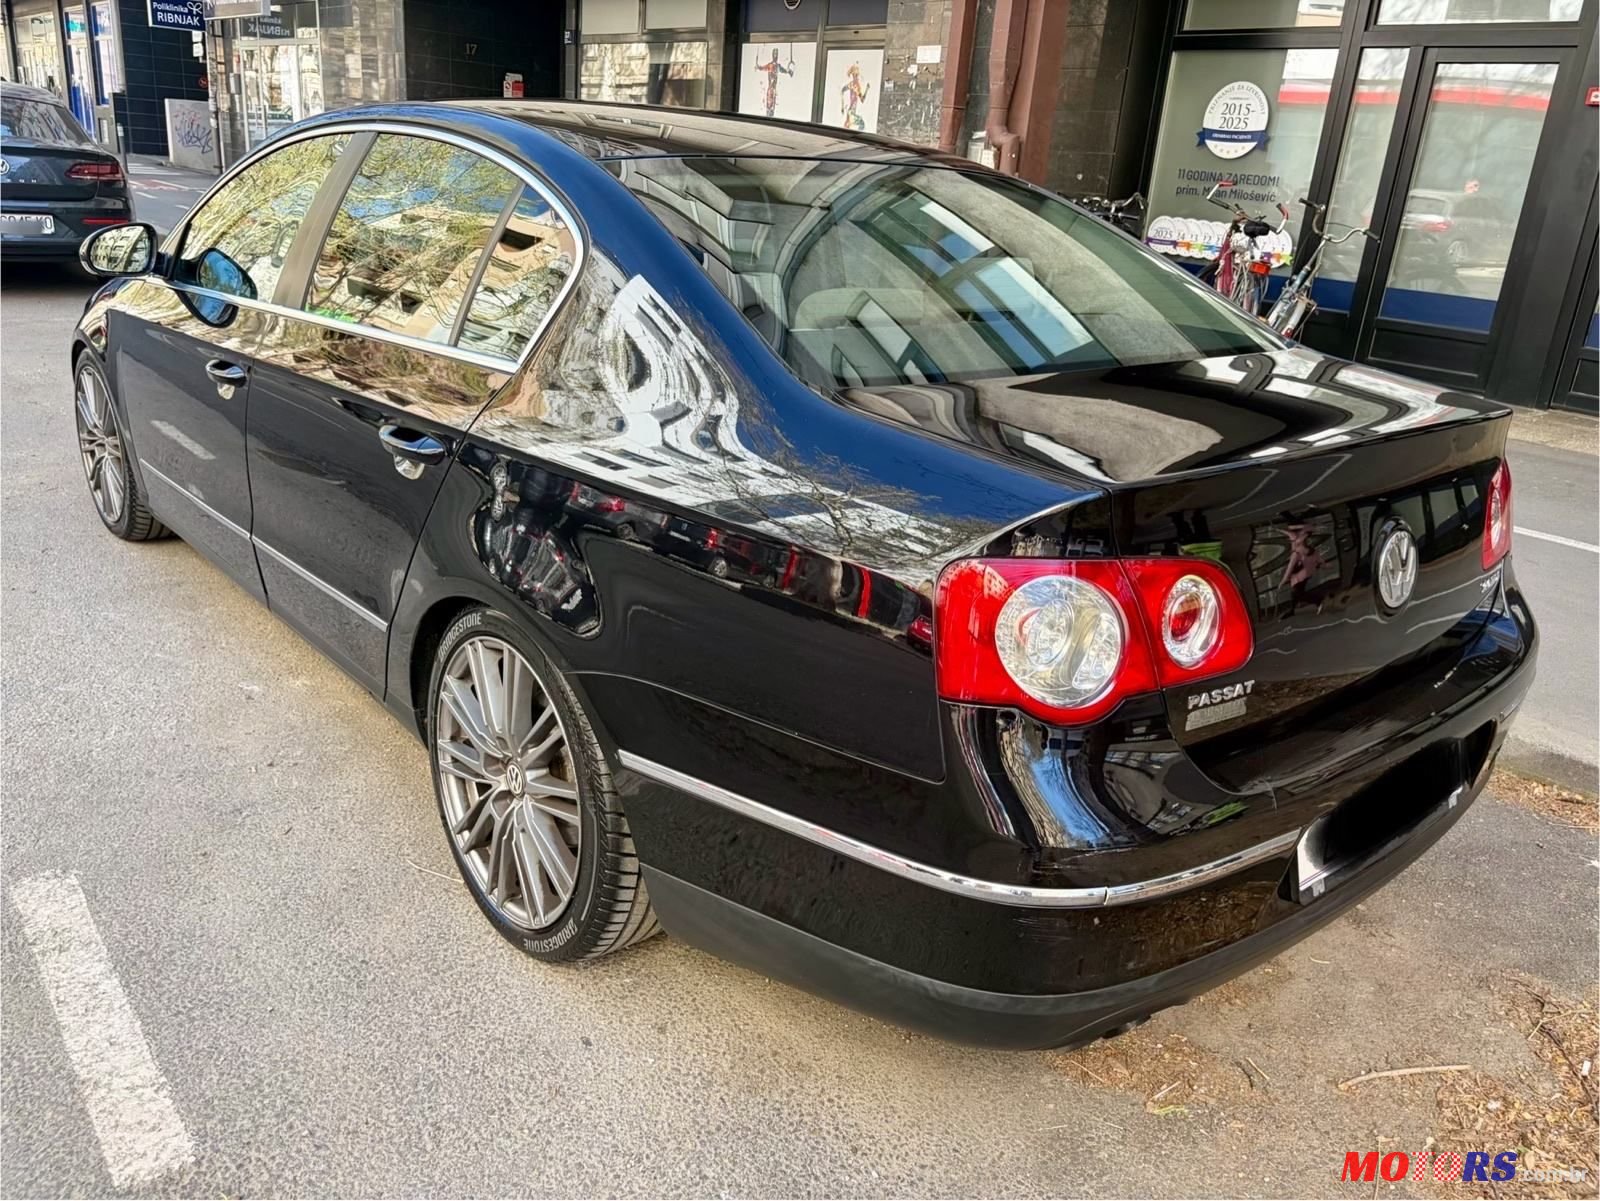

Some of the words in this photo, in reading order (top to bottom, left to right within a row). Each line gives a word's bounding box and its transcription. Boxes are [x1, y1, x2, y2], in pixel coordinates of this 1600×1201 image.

[153, 2, 188, 13] Poliklinika
[157, 12, 200, 26] RIBNJAK
[466, 43, 477, 55] 17
[1221, 103, 1256, 116] 2015-
[1219, 117, 1249, 130] 2025
[1186, 169, 1223, 182] GODINA
[1224, 173, 1280, 187] ZAREDOM!
[1176, 184, 1200, 197] prim.
[1188, 680, 1255, 710] PASSAT
[524, 917, 578, 953] BRIDGESTONE
